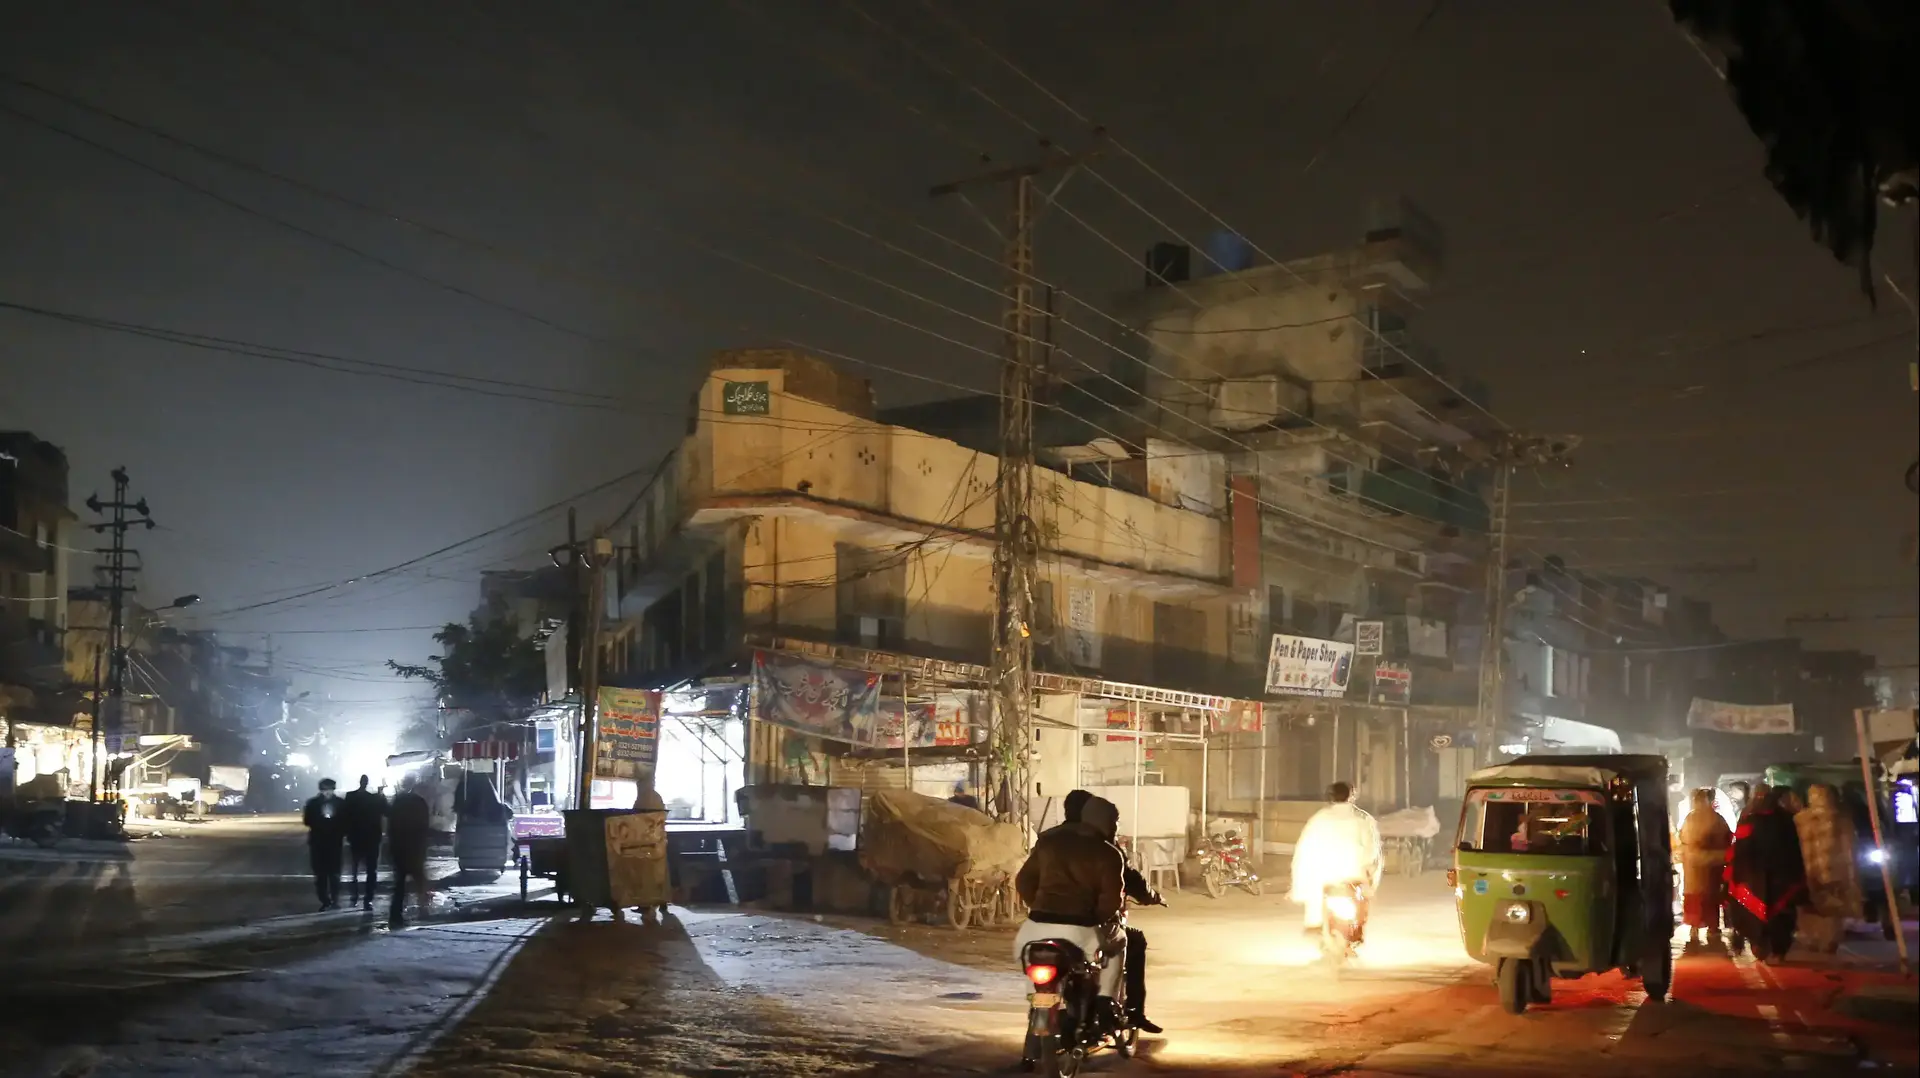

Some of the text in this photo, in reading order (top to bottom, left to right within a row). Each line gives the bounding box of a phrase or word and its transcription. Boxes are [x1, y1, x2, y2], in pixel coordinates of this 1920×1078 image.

[1274, 637, 1337, 668] Pen & Paper Shop
